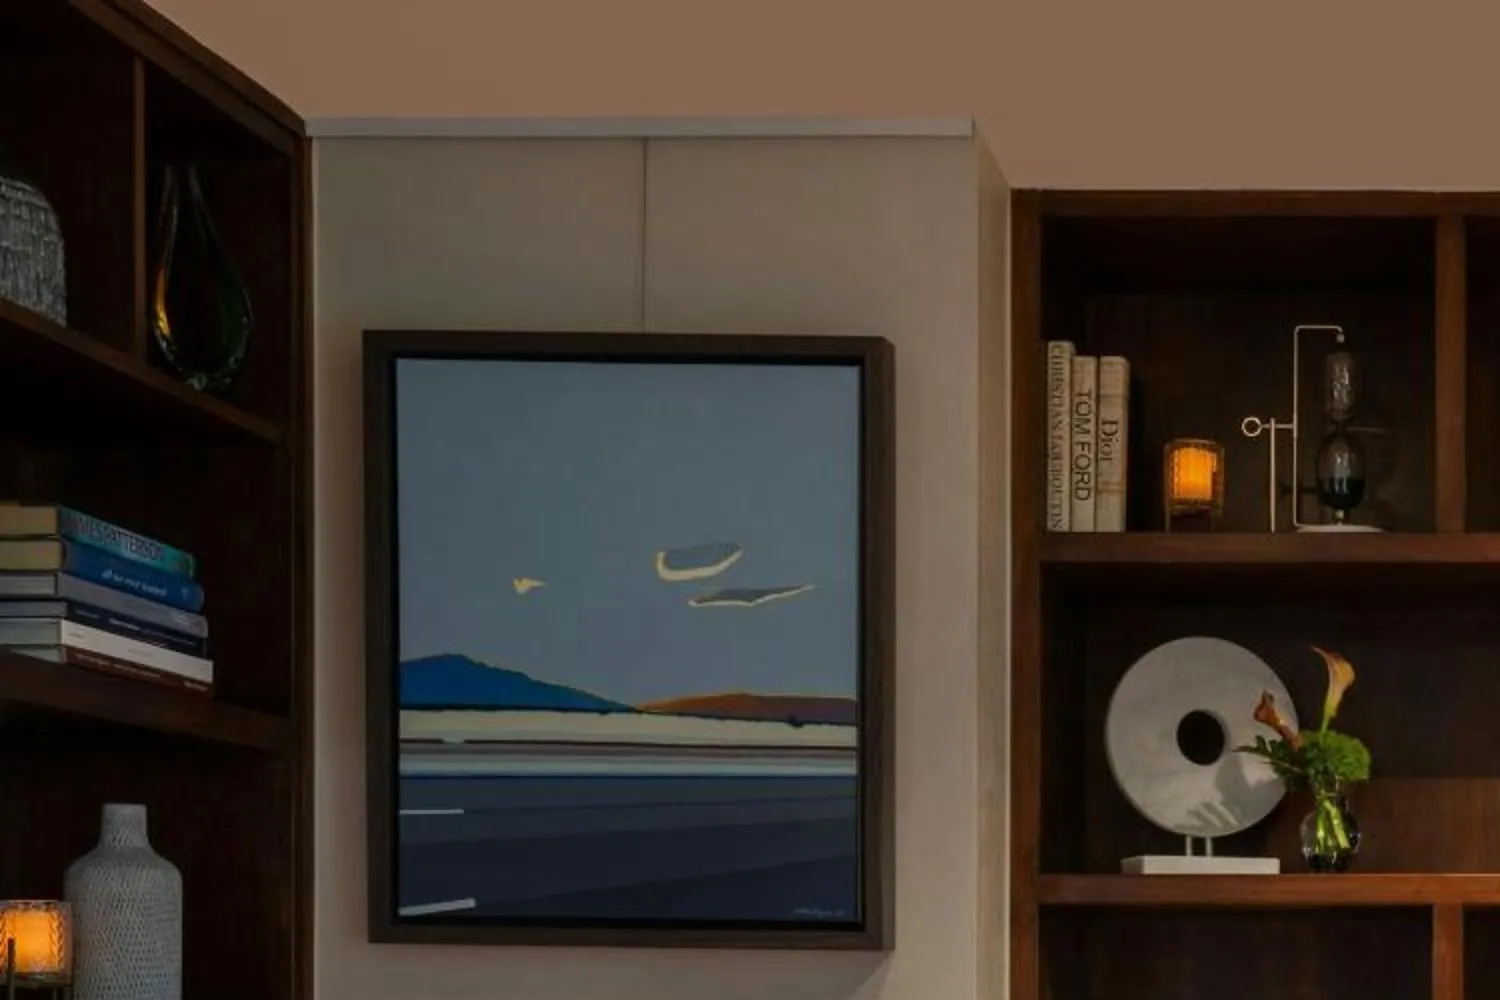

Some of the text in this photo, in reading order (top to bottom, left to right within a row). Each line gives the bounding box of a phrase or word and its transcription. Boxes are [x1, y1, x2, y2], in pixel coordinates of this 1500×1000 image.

[1074, 388, 1092, 501] TOM FORD
[1100, 418, 1119, 461] Dior
